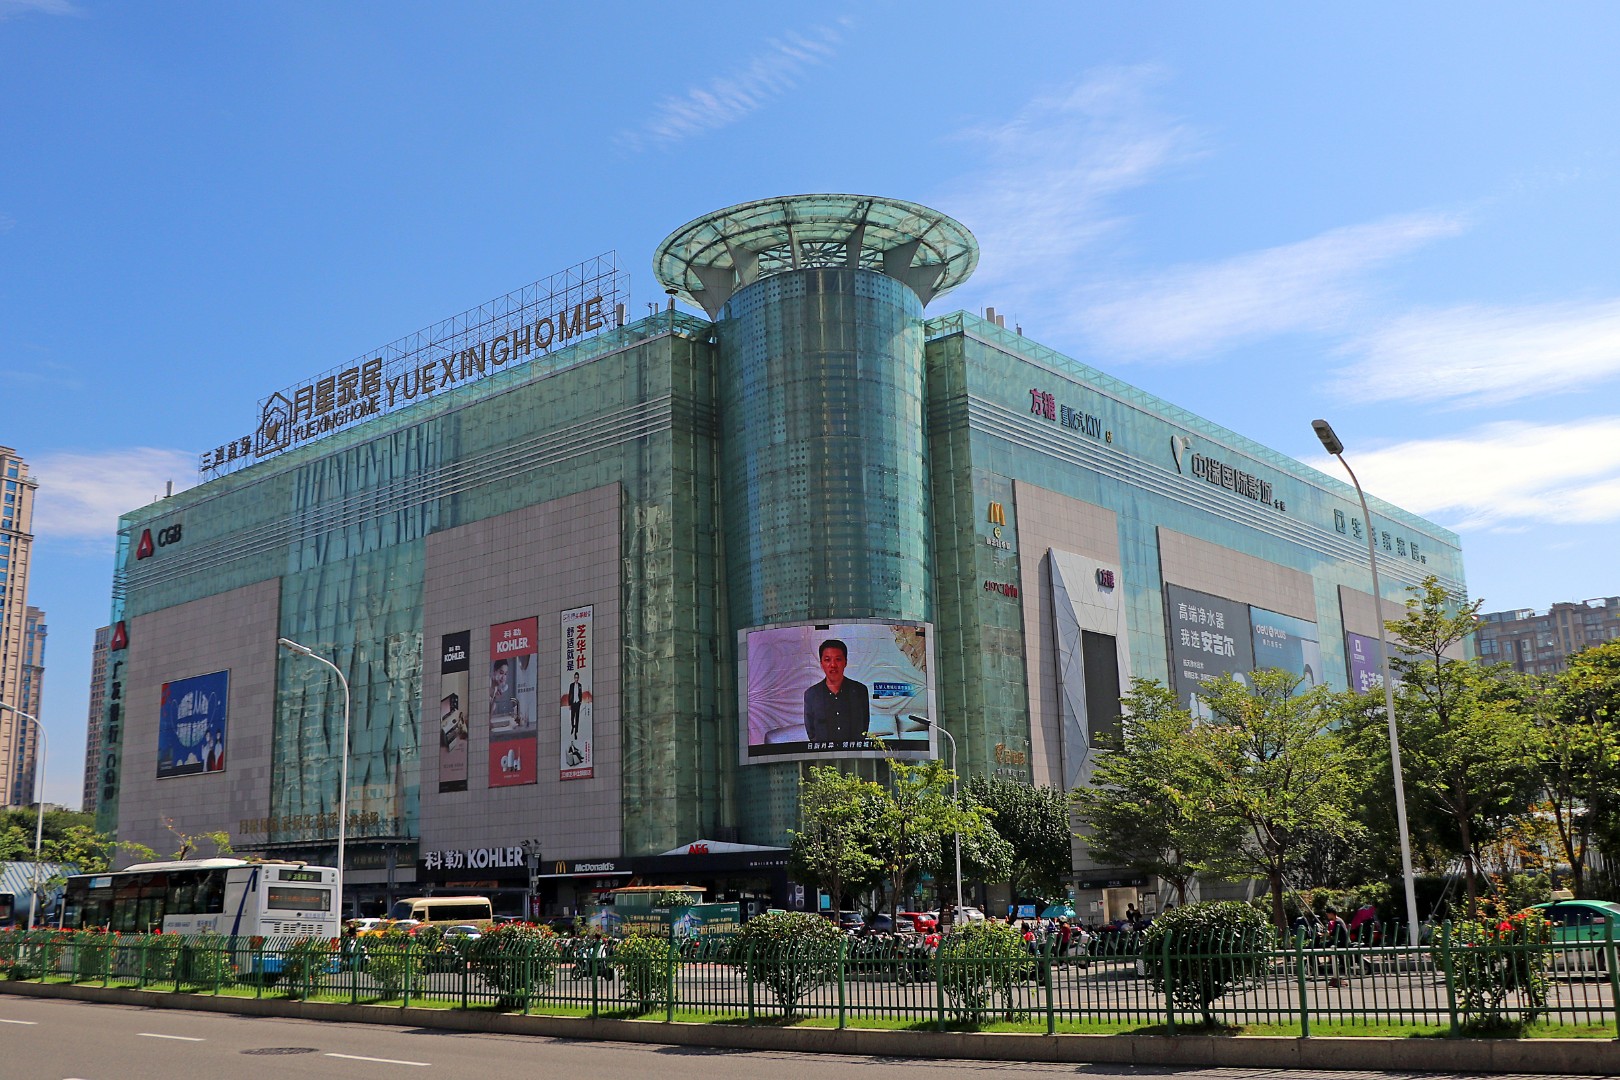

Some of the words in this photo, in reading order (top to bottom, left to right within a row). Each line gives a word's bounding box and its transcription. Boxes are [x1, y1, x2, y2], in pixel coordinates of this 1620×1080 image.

[387, 296, 602, 407] YUEXINGHOME
[293, 357, 382, 425] 月星家居
[292, 395, 381, 443] YUEXINGHOME
[1191, 453, 1273, 506] 中瑞国际影城
[157, 523, 182, 547] CGB
[1178, 602, 1225, 630] 高端净水器
[496, 637, 528, 653] KOHLER
[503, 628, 522, 638] 科勒
[1181, 628, 1236, 657] 我选安吉尔
[444, 651, 465, 663] KOHLER
[566, 626, 575, 671] 舒适就是
[576, 624, 586, 670] 芝华仕
[425, 850, 463, 870] 科勒
[467, 842, 524, 869] KOHLER
[688, 844, 709, 855] AEG
[575, 862, 615, 872] McDonald's
